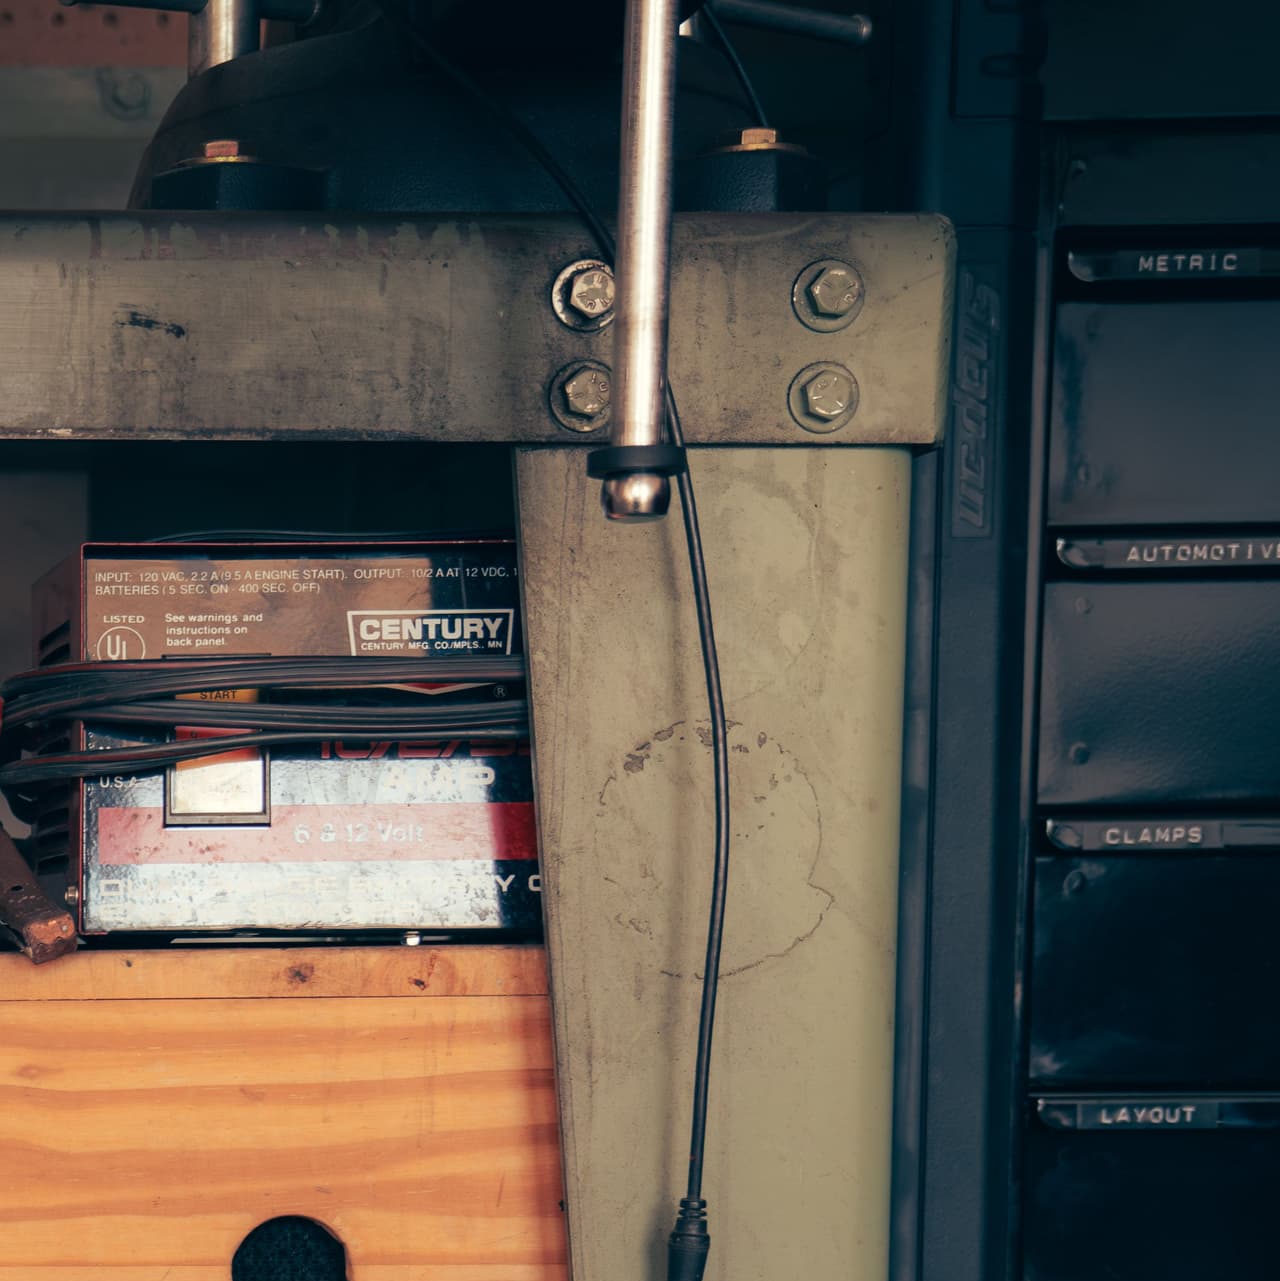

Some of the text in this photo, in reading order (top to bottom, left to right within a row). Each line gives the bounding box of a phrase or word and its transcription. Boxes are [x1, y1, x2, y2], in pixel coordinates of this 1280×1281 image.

[1139, 253, 1238, 272] METRIC
[95, 572, 133, 582] INPUT:
[139, 572, 159, 582] 120
[191, 571, 208, 581] 2.2
[210, 571, 219, 581] A
[244, 570, 252, 580] A
[255, 570, 299, 580] ENGINE
[411, 568, 433, 578] 10/2
[435, 568, 445, 577] A
[446, 568, 460, 577] AT
[466, 567, 477, 577] 12
[95, 585, 159, 596] BATTERIES
[180, 585, 207, 594] SEC.
[210, 584, 228, 594] ON
[239, 583, 258, 593] 400
[262, 583, 289, 593] SEC.
[293, 582, 320, 593] OFF)
[103, 615, 145, 624] LISTED
[165, 613, 263, 624] See warnings and
[166, 626, 231, 635] instructions
[359, 617, 503, 641] CENTURY
[167, 638, 191, 647] back
[361, 642, 404, 651] CENTURY
[488, 640, 502, 649] MN
[200, 690, 237, 701] START
[384, 766, 495, 794] AMP
[294, 824, 310, 844] 6
[345, 824, 369, 843] 12
[377, 822, 424, 843] Volt
[1106, 826, 1202, 845] CLAMPS
[1100, 1106, 1195, 1125] LAYOUT
